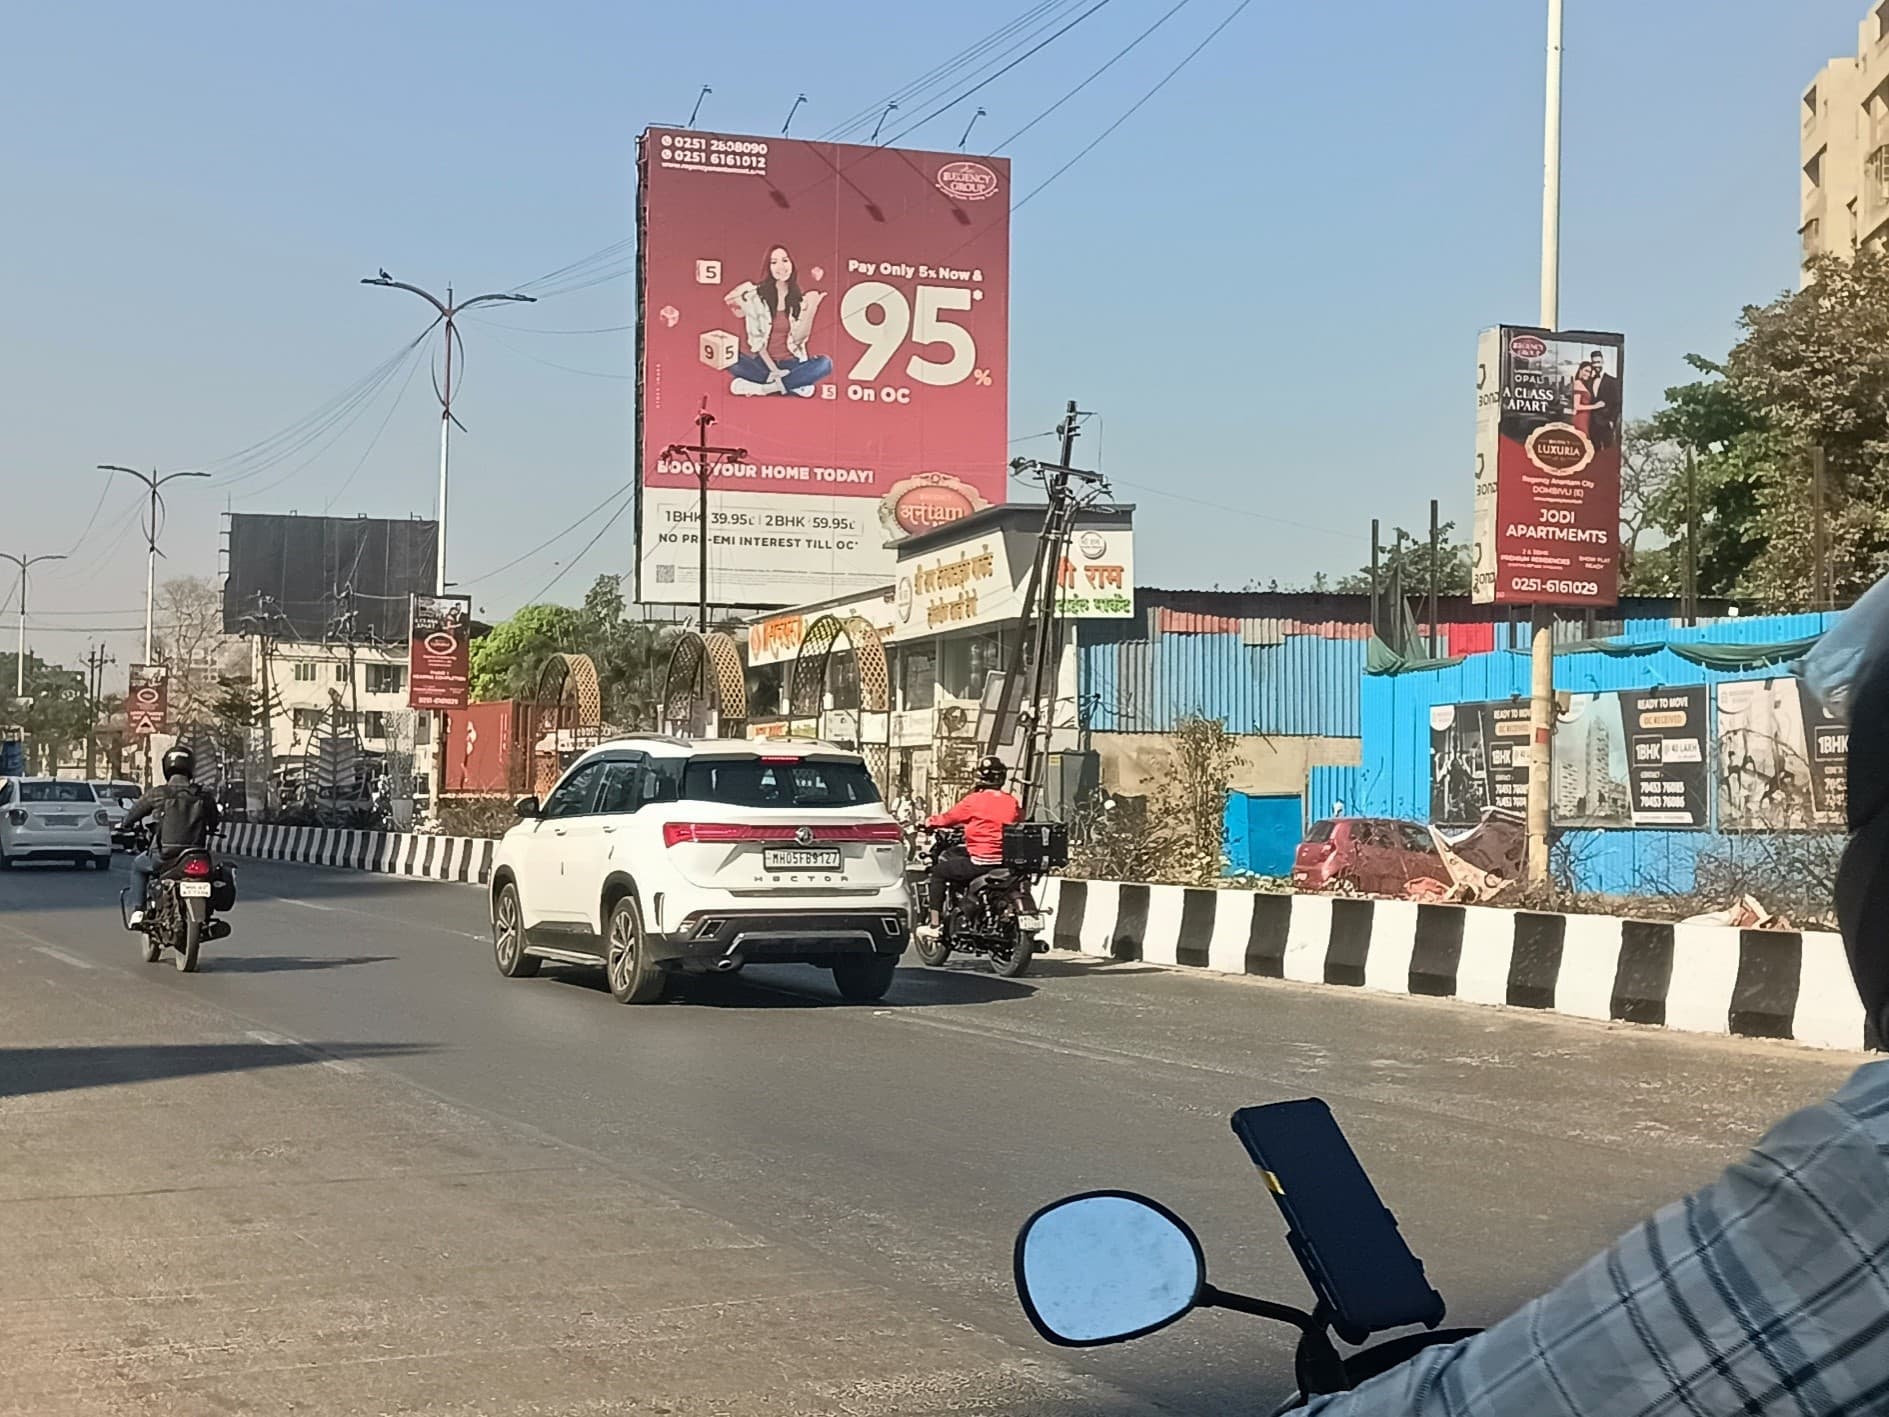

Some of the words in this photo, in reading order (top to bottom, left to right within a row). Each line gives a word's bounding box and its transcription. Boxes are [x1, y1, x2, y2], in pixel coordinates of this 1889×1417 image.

[674, 136, 706, 150] 0251
[674, 149, 706, 163] 0251
[710, 153, 767, 168] 6161012
[848, 259, 877, 276] Pay
[880, 262, 915, 279] Only
[939, 267, 971, 281] Now
[972, 269, 983, 281] &
[847, 384, 876, 401] On
[880, 386, 911, 404] OC
[1503, 386, 1511, 398] A
[1514, 387, 1554, 401] CLASS
[1507, 398, 1547, 413] APART
[1537, 444, 1581, 457] LUXURIA
[710, 462, 757, 477] YOUR
[761, 465, 810, 480] HOME
[814, 467, 874, 483] TODAY!
[765, 515, 805, 528] 2BHK
[1539, 508, 1575, 524] JODI
[659, 533, 678, 544] NO
[682, 534, 735, 546] PR-EMI
[740, 536, 802, 548] INTEREST
[806, 539, 832, 549] TILL
[1084, 565, 1124, 590] राम
[1511, 576, 1598, 595] 0251-6161029
[1635, 743, 1661, 760] 1BHK
